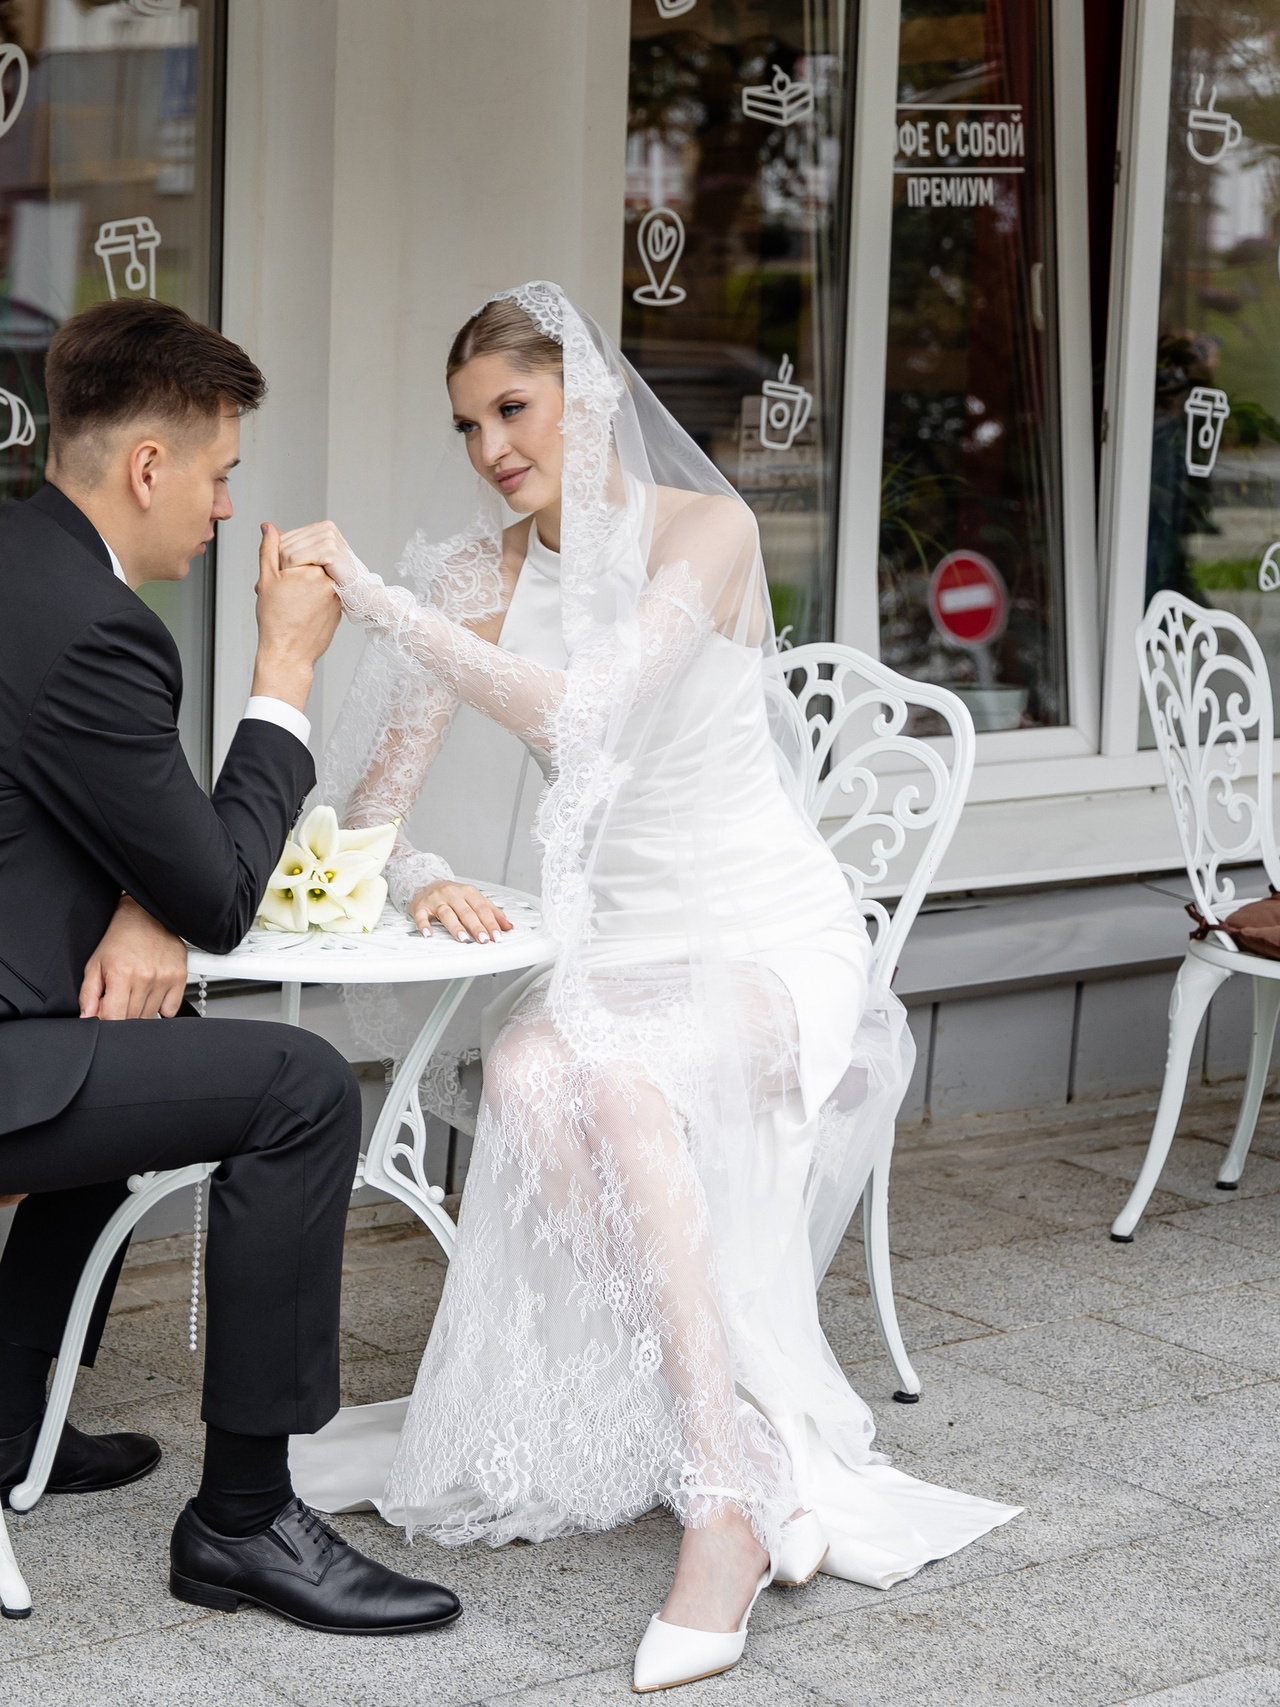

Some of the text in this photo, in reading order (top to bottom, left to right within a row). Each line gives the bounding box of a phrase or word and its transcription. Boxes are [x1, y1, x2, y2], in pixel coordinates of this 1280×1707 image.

[935, 121, 951, 157] С
[955, 113, 1025, 158] СОБОЙ
[907, 176, 995, 207] ПРЕМИУМ
